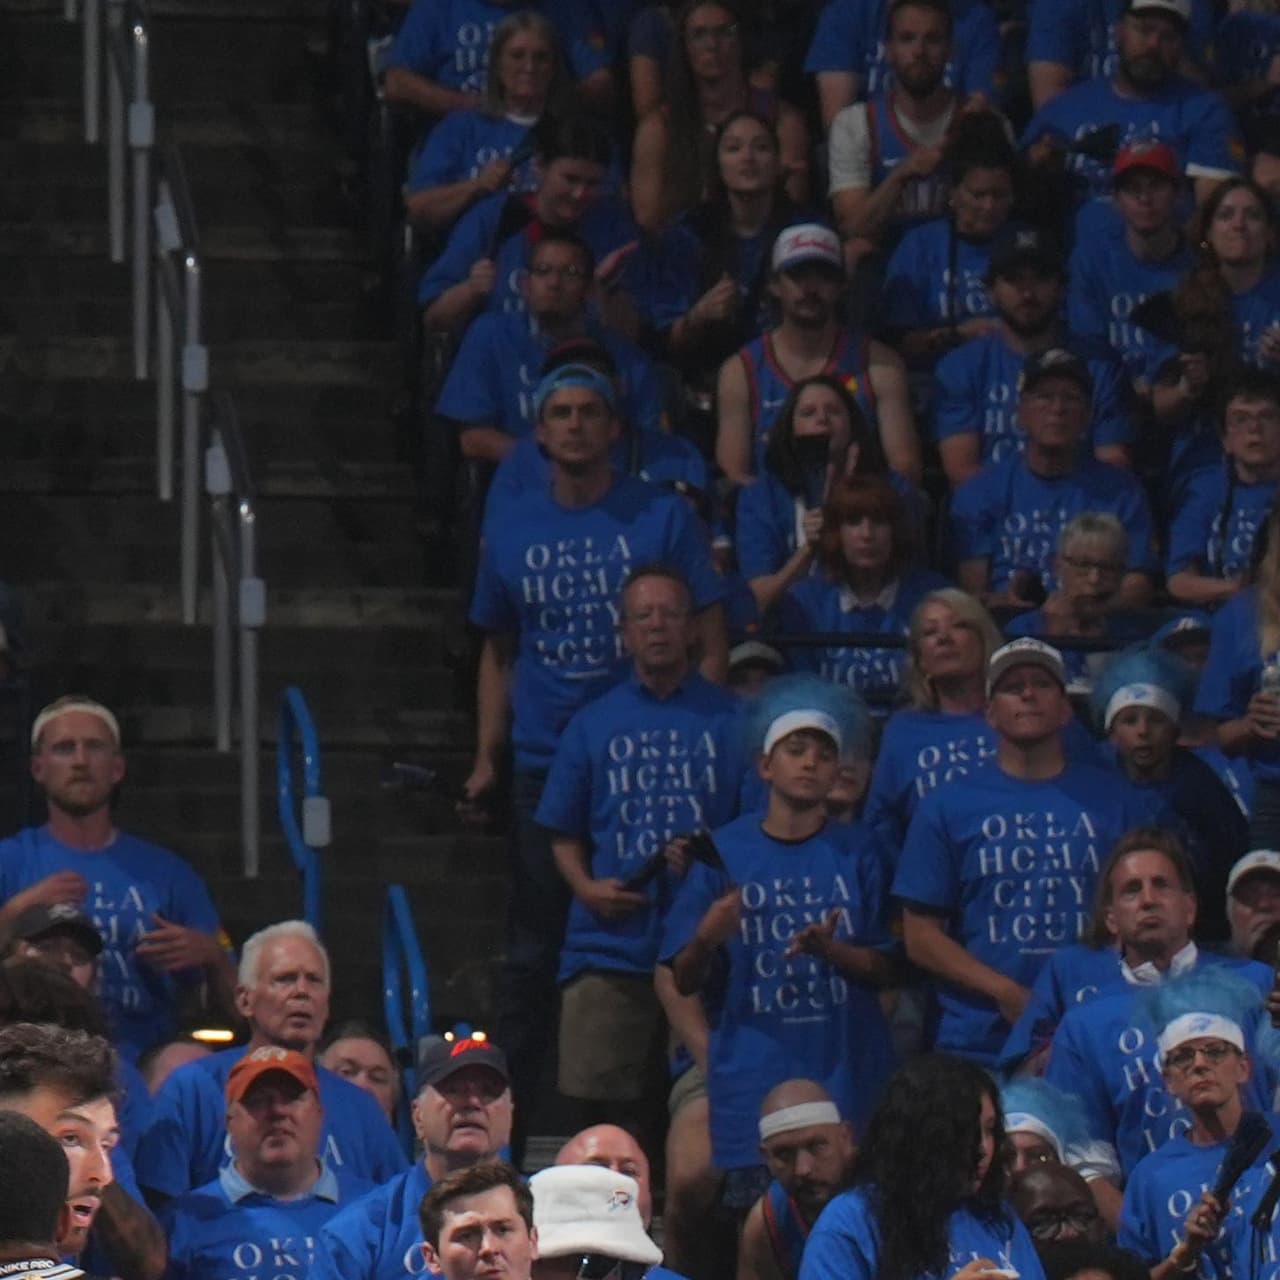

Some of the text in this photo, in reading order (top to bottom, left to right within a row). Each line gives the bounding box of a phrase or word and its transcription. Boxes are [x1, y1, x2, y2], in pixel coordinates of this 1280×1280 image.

[525, 534, 632, 571] OKLA
[608, 729, 716, 763] OKLA
[918, 736, 997, 770] OKL
[607, 764, 717, 795] HOMA
[981, 812, 1096, 842] OKLA
[616, 830, 670, 861] LO
[978, 843, 1099, 876] HOMA
[741, 875, 850, 910] OKLA
[993, 875, 1087, 908] CITY
[756, 948, 825, 979] CIT
[233, 1237, 315, 1270] OKL
